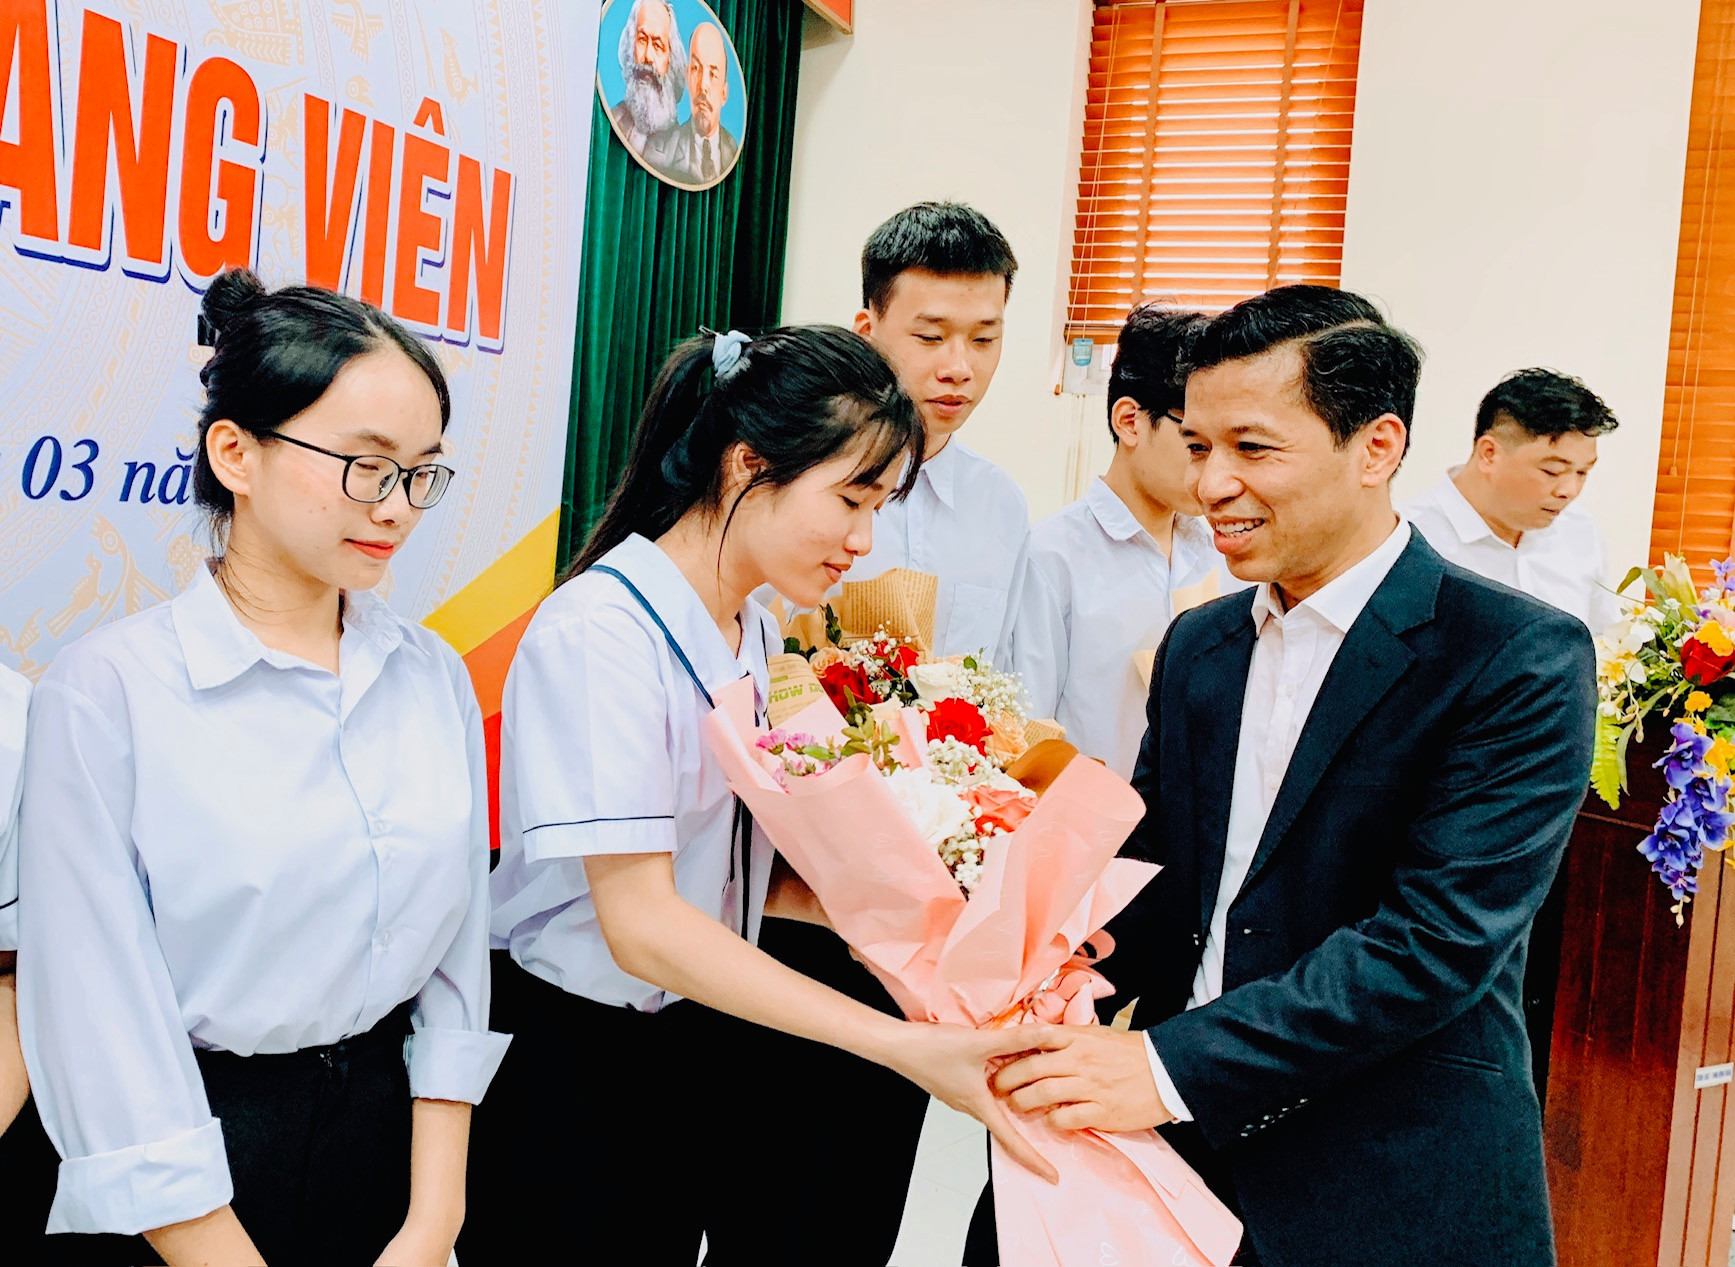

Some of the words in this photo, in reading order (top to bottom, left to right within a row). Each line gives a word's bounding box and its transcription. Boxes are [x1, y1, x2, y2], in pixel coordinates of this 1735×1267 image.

[303, 92, 511, 340] VIÊN
[21, 435, 100, 500] 03
[119, 447, 194, 505] nă
